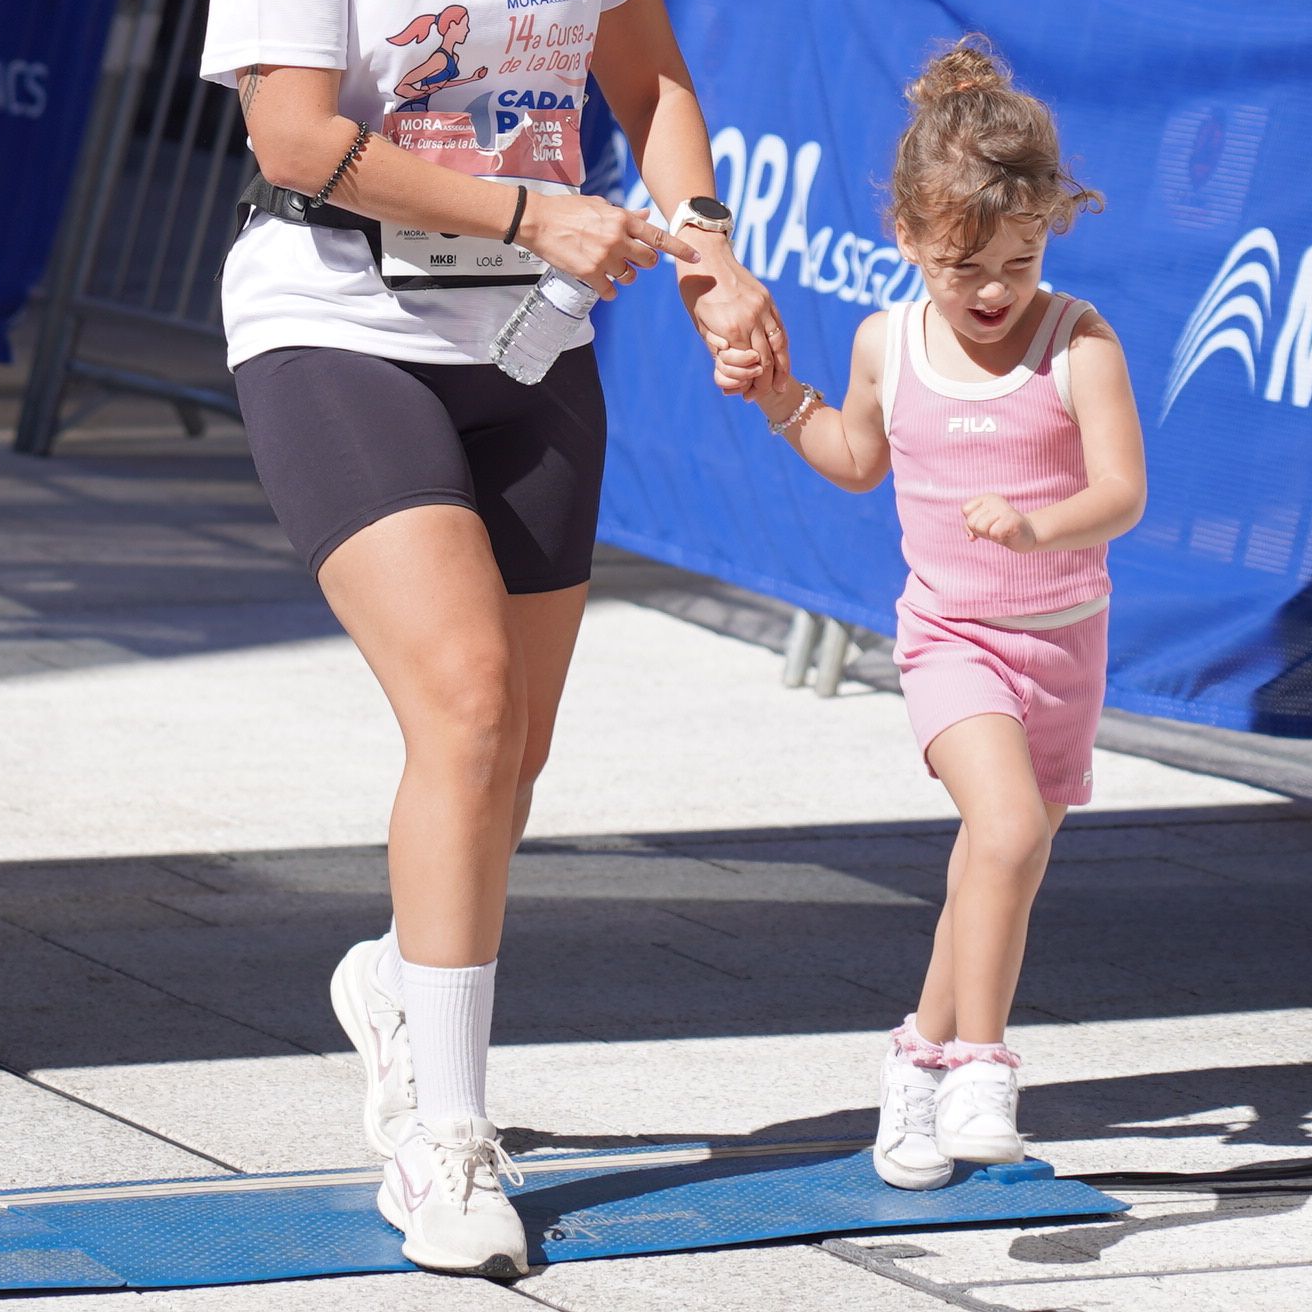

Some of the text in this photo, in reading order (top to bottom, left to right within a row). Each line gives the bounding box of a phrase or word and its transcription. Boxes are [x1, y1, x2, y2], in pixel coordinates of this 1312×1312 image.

[546, 23, 584, 48] Cursa
[498, 56, 522, 74] de
[526, 54, 546, 72] la
[497, 89, 576, 110] CADA
[532, 121, 563, 133] CADA
[948, 417, 997, 433] FILA
